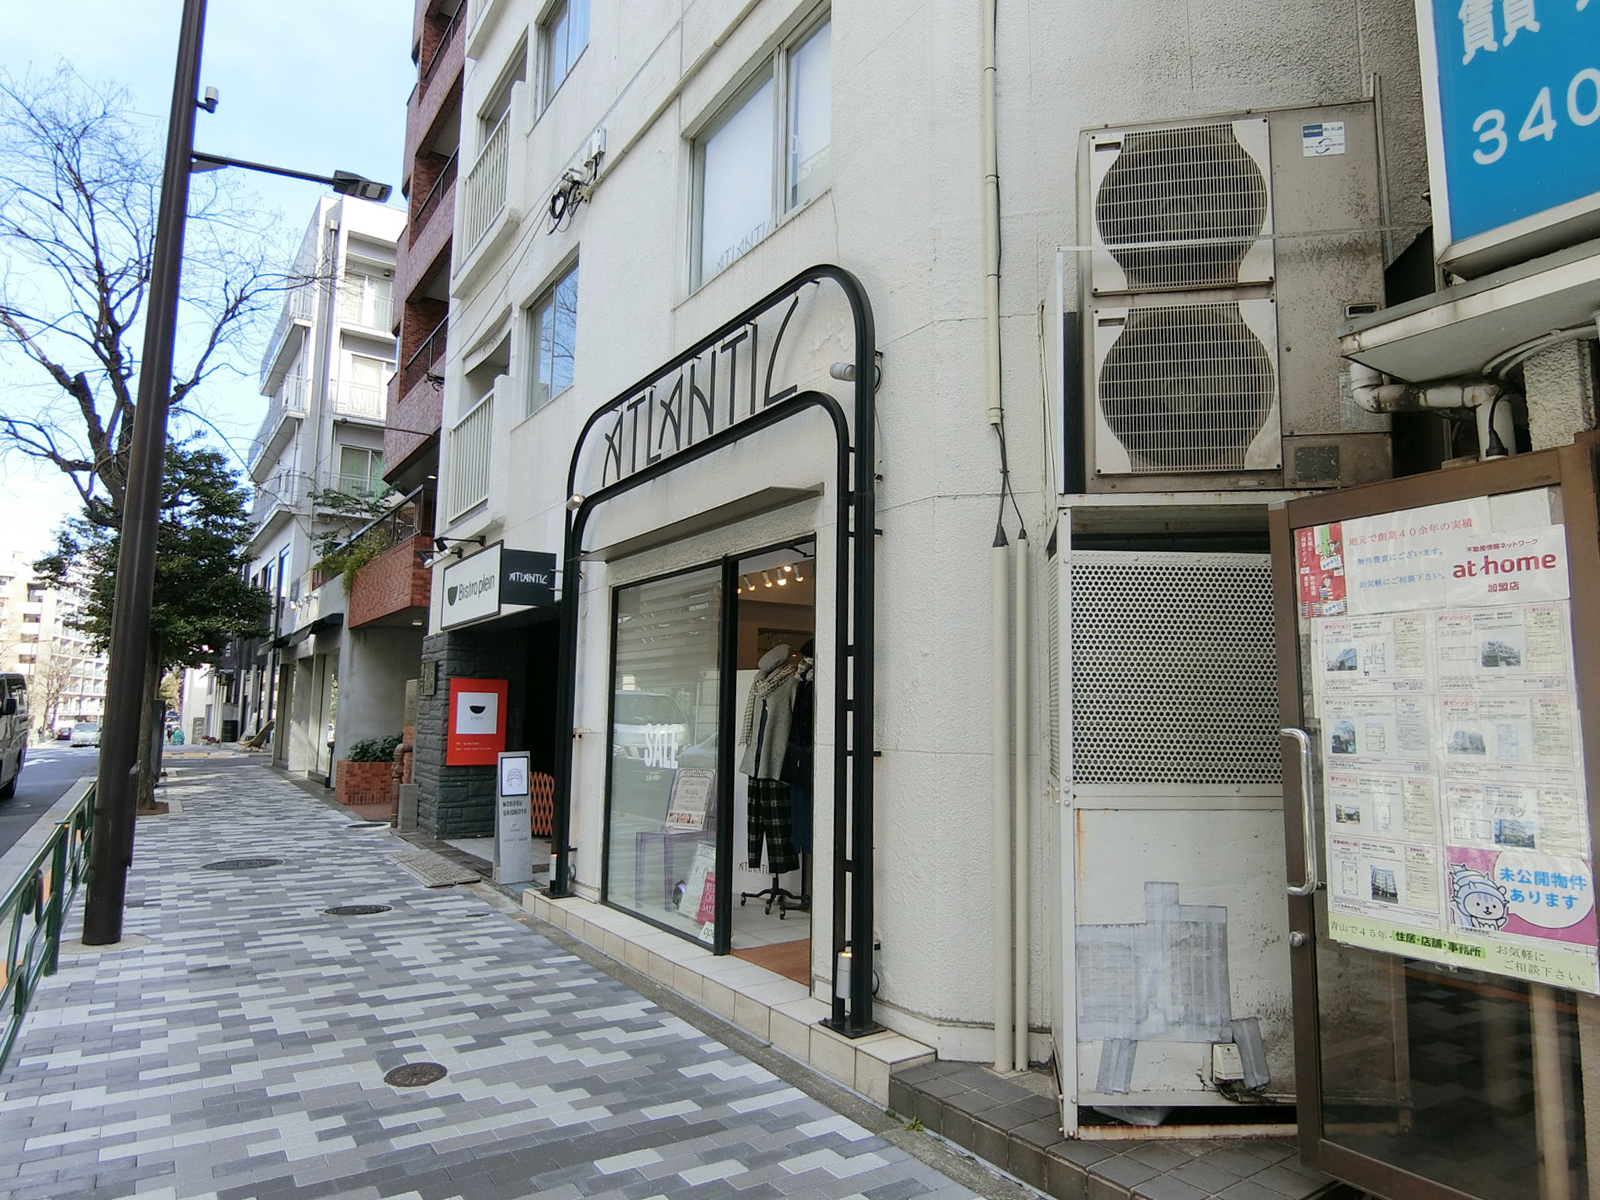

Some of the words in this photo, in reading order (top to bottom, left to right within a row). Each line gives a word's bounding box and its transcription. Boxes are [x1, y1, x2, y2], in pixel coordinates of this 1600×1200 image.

[602, 296, 799, 488] ATLANTIC
[1466, 538, 1539, 553] 不動産情報ネットワーク
[508, 571, 548, 585] ATLANTIC
[1487, 581, 1520, 593] 加盟店
[644, 723, 679, 769] SALE
[1500, 867, 1587, 891] 未公開物件
[1510, 888, 1578, 910] あります
[1496, 945, 1547, 962] お気軽に
